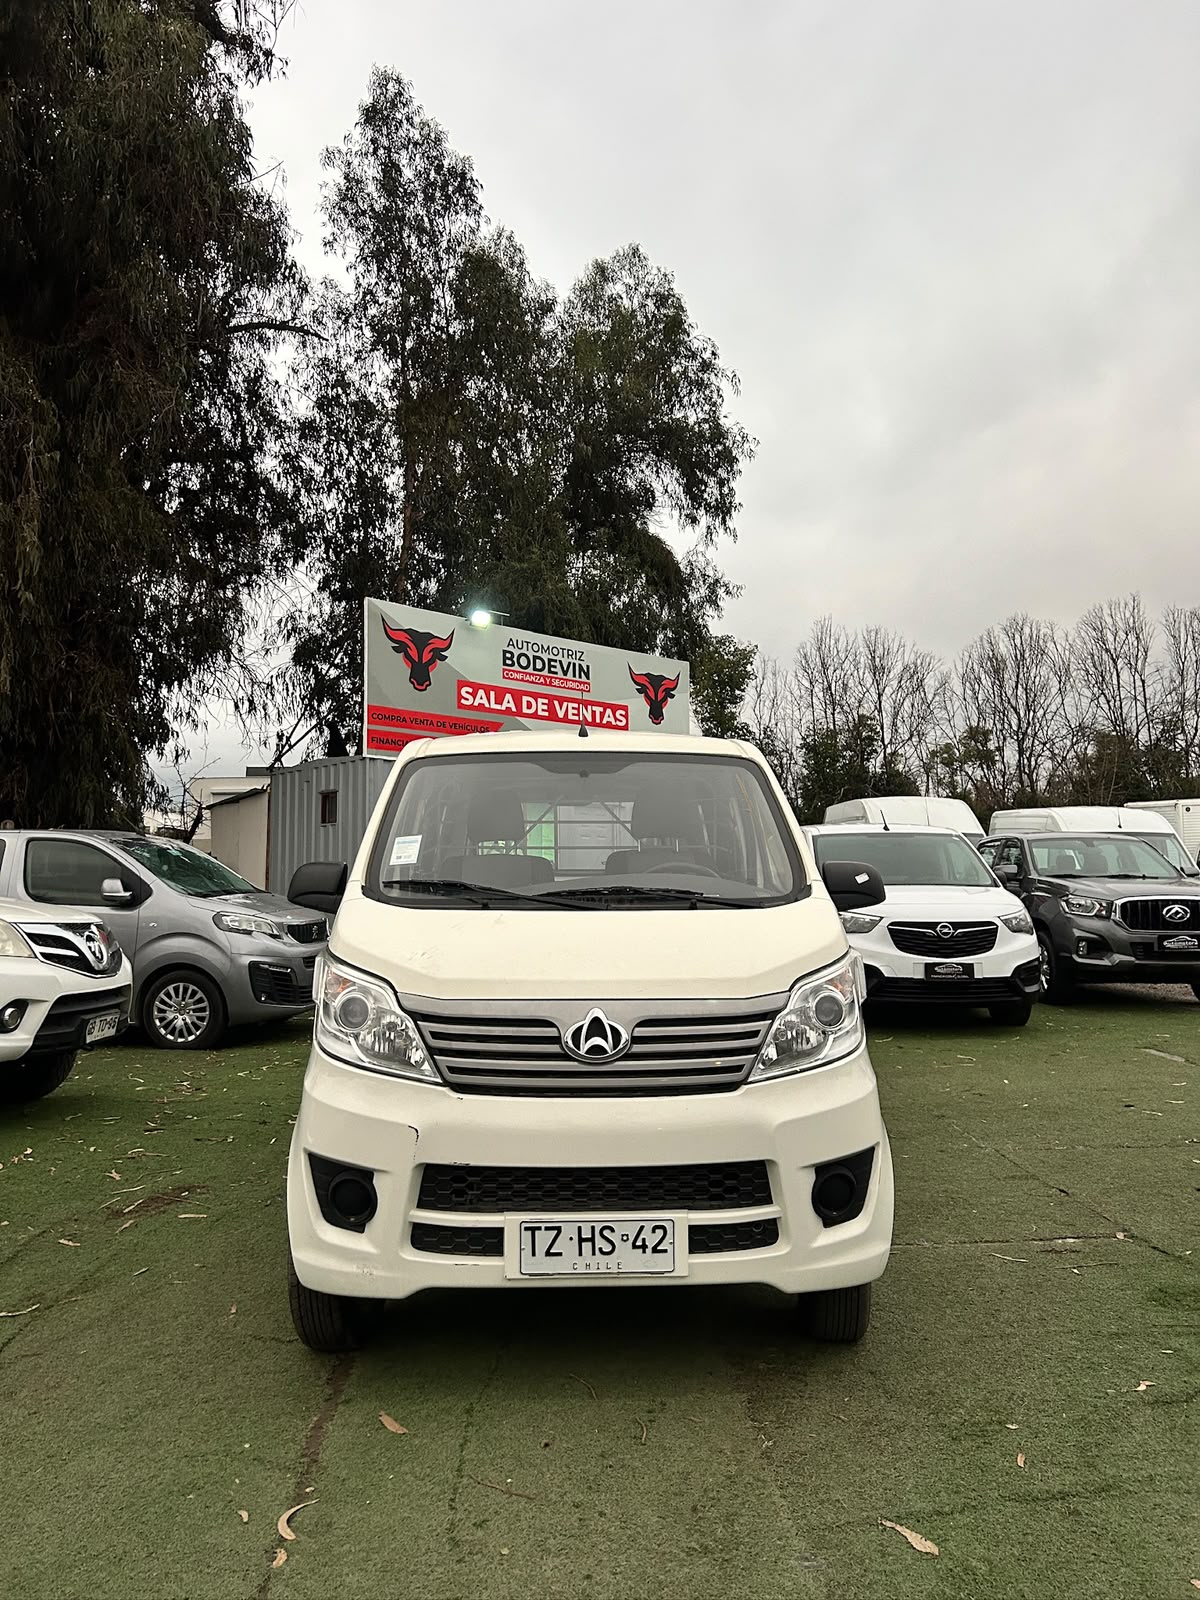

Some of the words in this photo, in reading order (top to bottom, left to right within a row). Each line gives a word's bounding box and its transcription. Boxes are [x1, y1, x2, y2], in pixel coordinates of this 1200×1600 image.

[507, 638, 585, 662] AUTOMOTRIZ
[502, 650, 590, 681] BODEVIN
[503, 670, 544, 684] CONFIANZA
[545, 677, 551, 685] Y
[552, 678, 590, 692] SEGURIDAD
[460, 687, 517, 712] SALA
[522, 695, 549, 717] DE
[553, 700, 627, 727] VENTAS
[371, 712, 407, 724] COMPRA
[408, 717, 435, 727] VENTA
[436, 720, 447, 728] DE
[572, 1261, 623, 1271] CHILE
